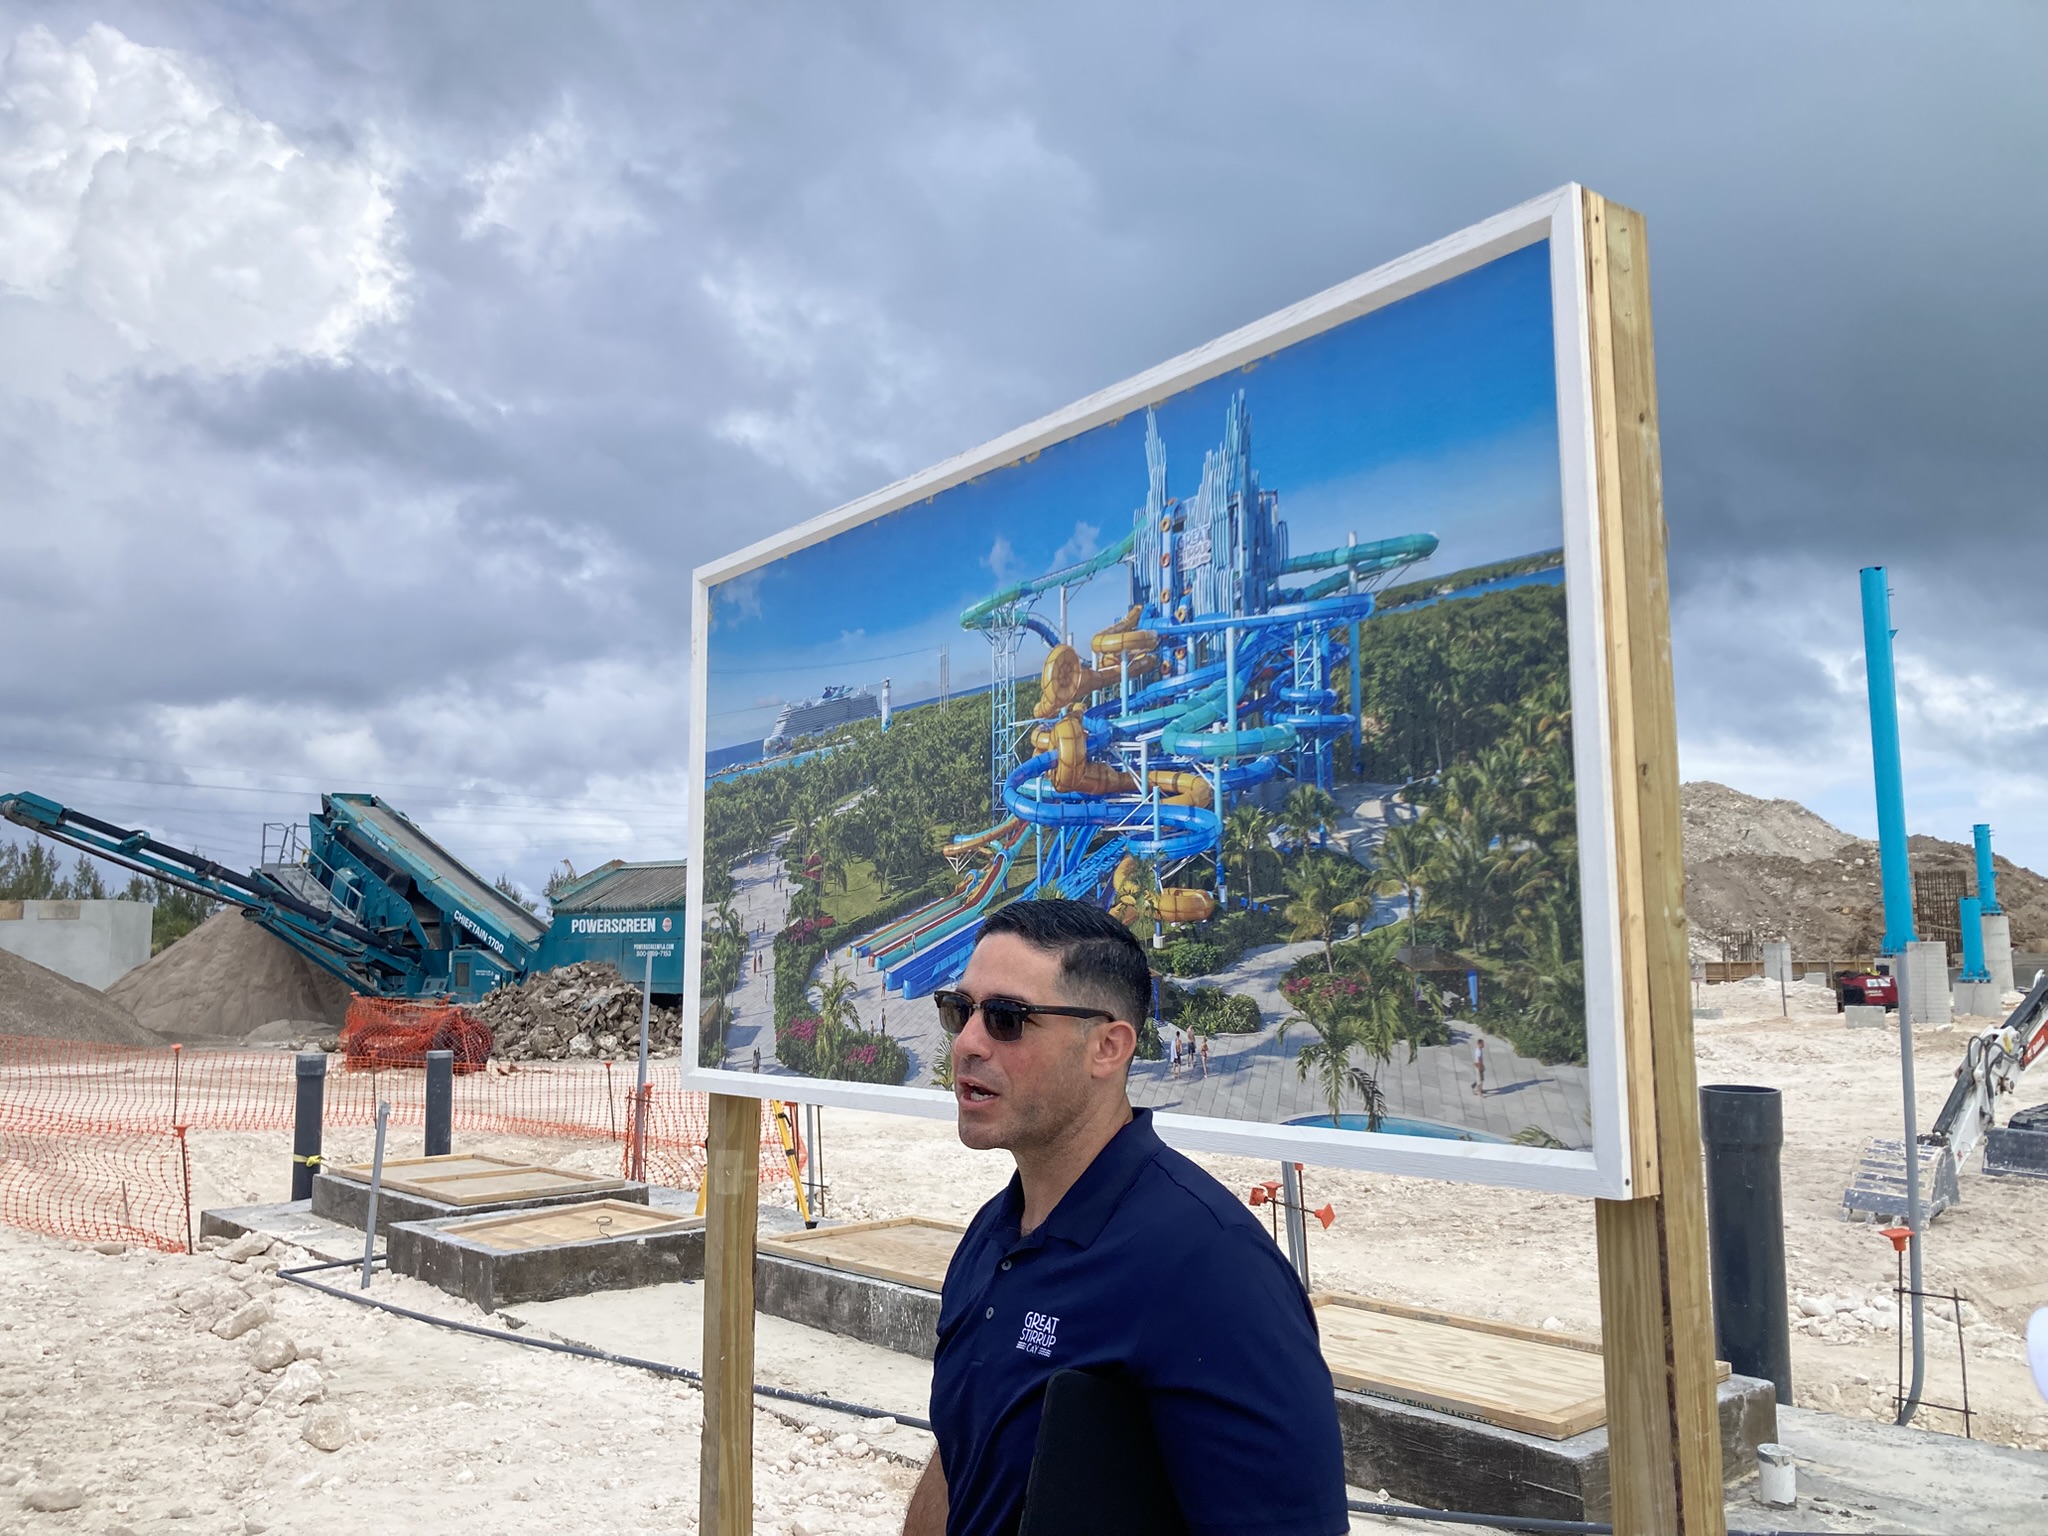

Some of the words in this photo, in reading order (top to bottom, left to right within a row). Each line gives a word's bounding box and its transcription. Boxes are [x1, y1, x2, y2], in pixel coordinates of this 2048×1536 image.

[453, 910, 488, 942] CHIEFTAIN
[487, 935, 505, 954] 1700
[571, 918, 656, 934] POWERSCREEN
[1024, 1311, 1060, 1335] GREAT
[1019, 1327, 1057, 1348] STIRRUP
[1026, 1342, 1039, 1354] CAY
